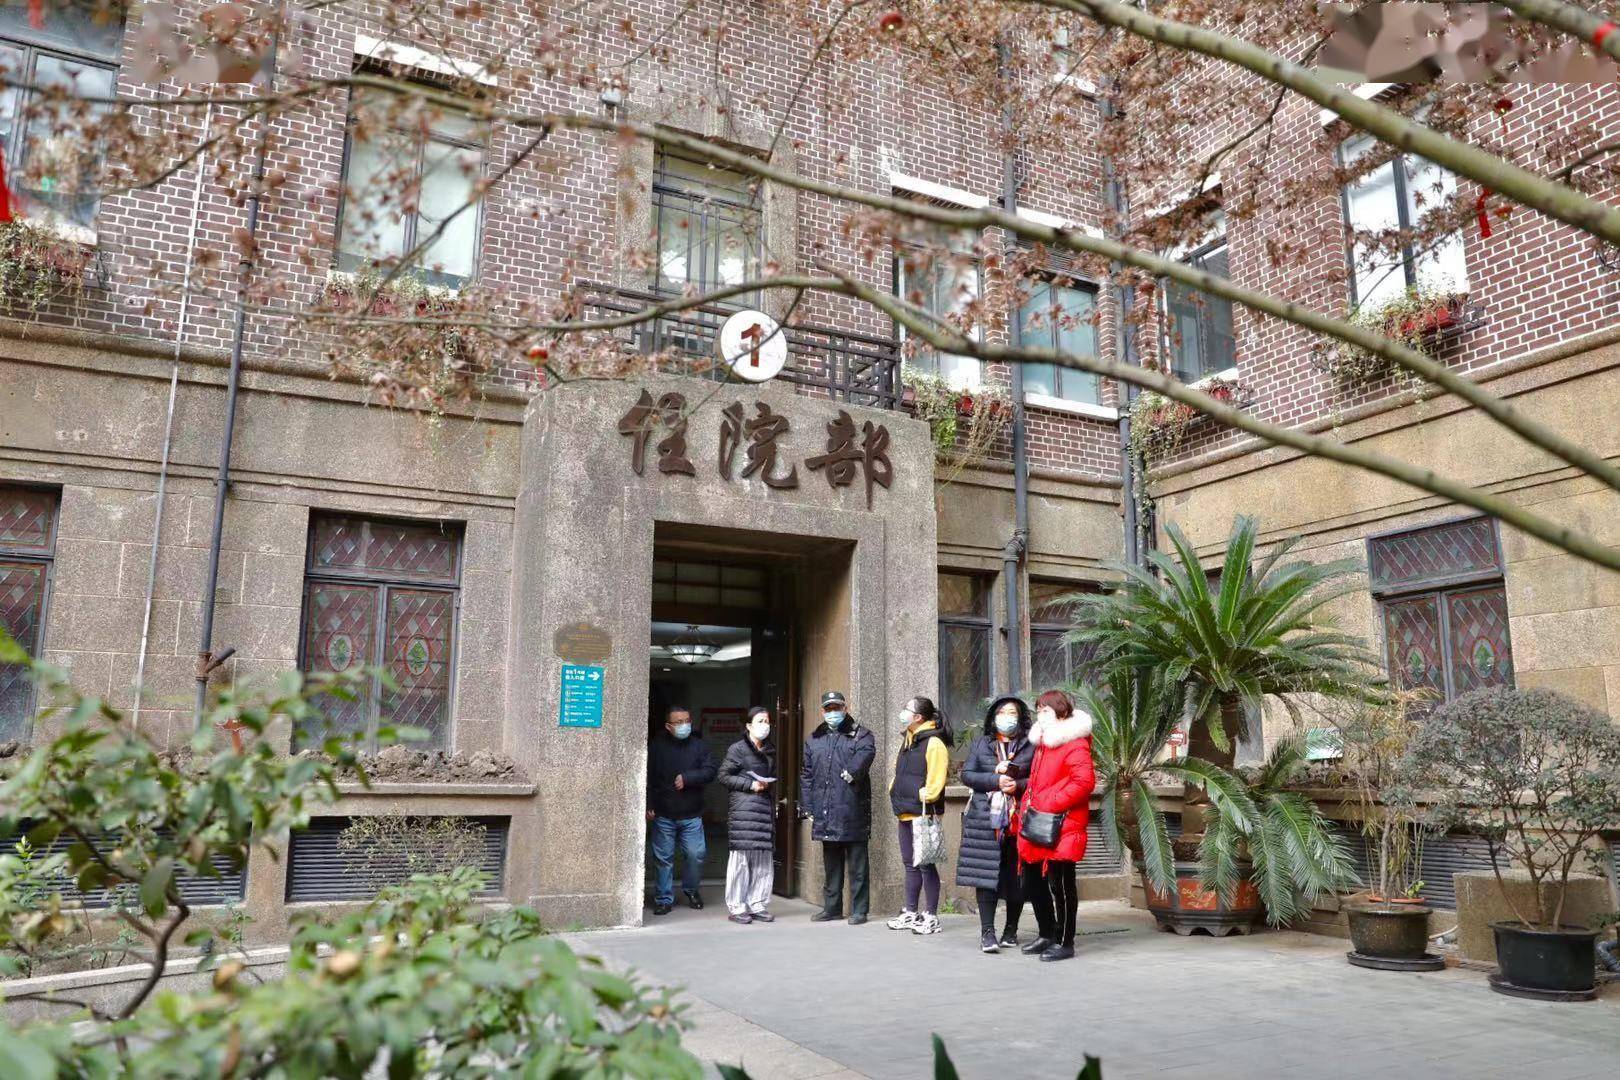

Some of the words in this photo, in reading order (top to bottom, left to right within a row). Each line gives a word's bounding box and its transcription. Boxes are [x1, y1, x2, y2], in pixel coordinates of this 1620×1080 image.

[741, 323, 761, 367] 1
[618, 388, 893, 511] 住院部
